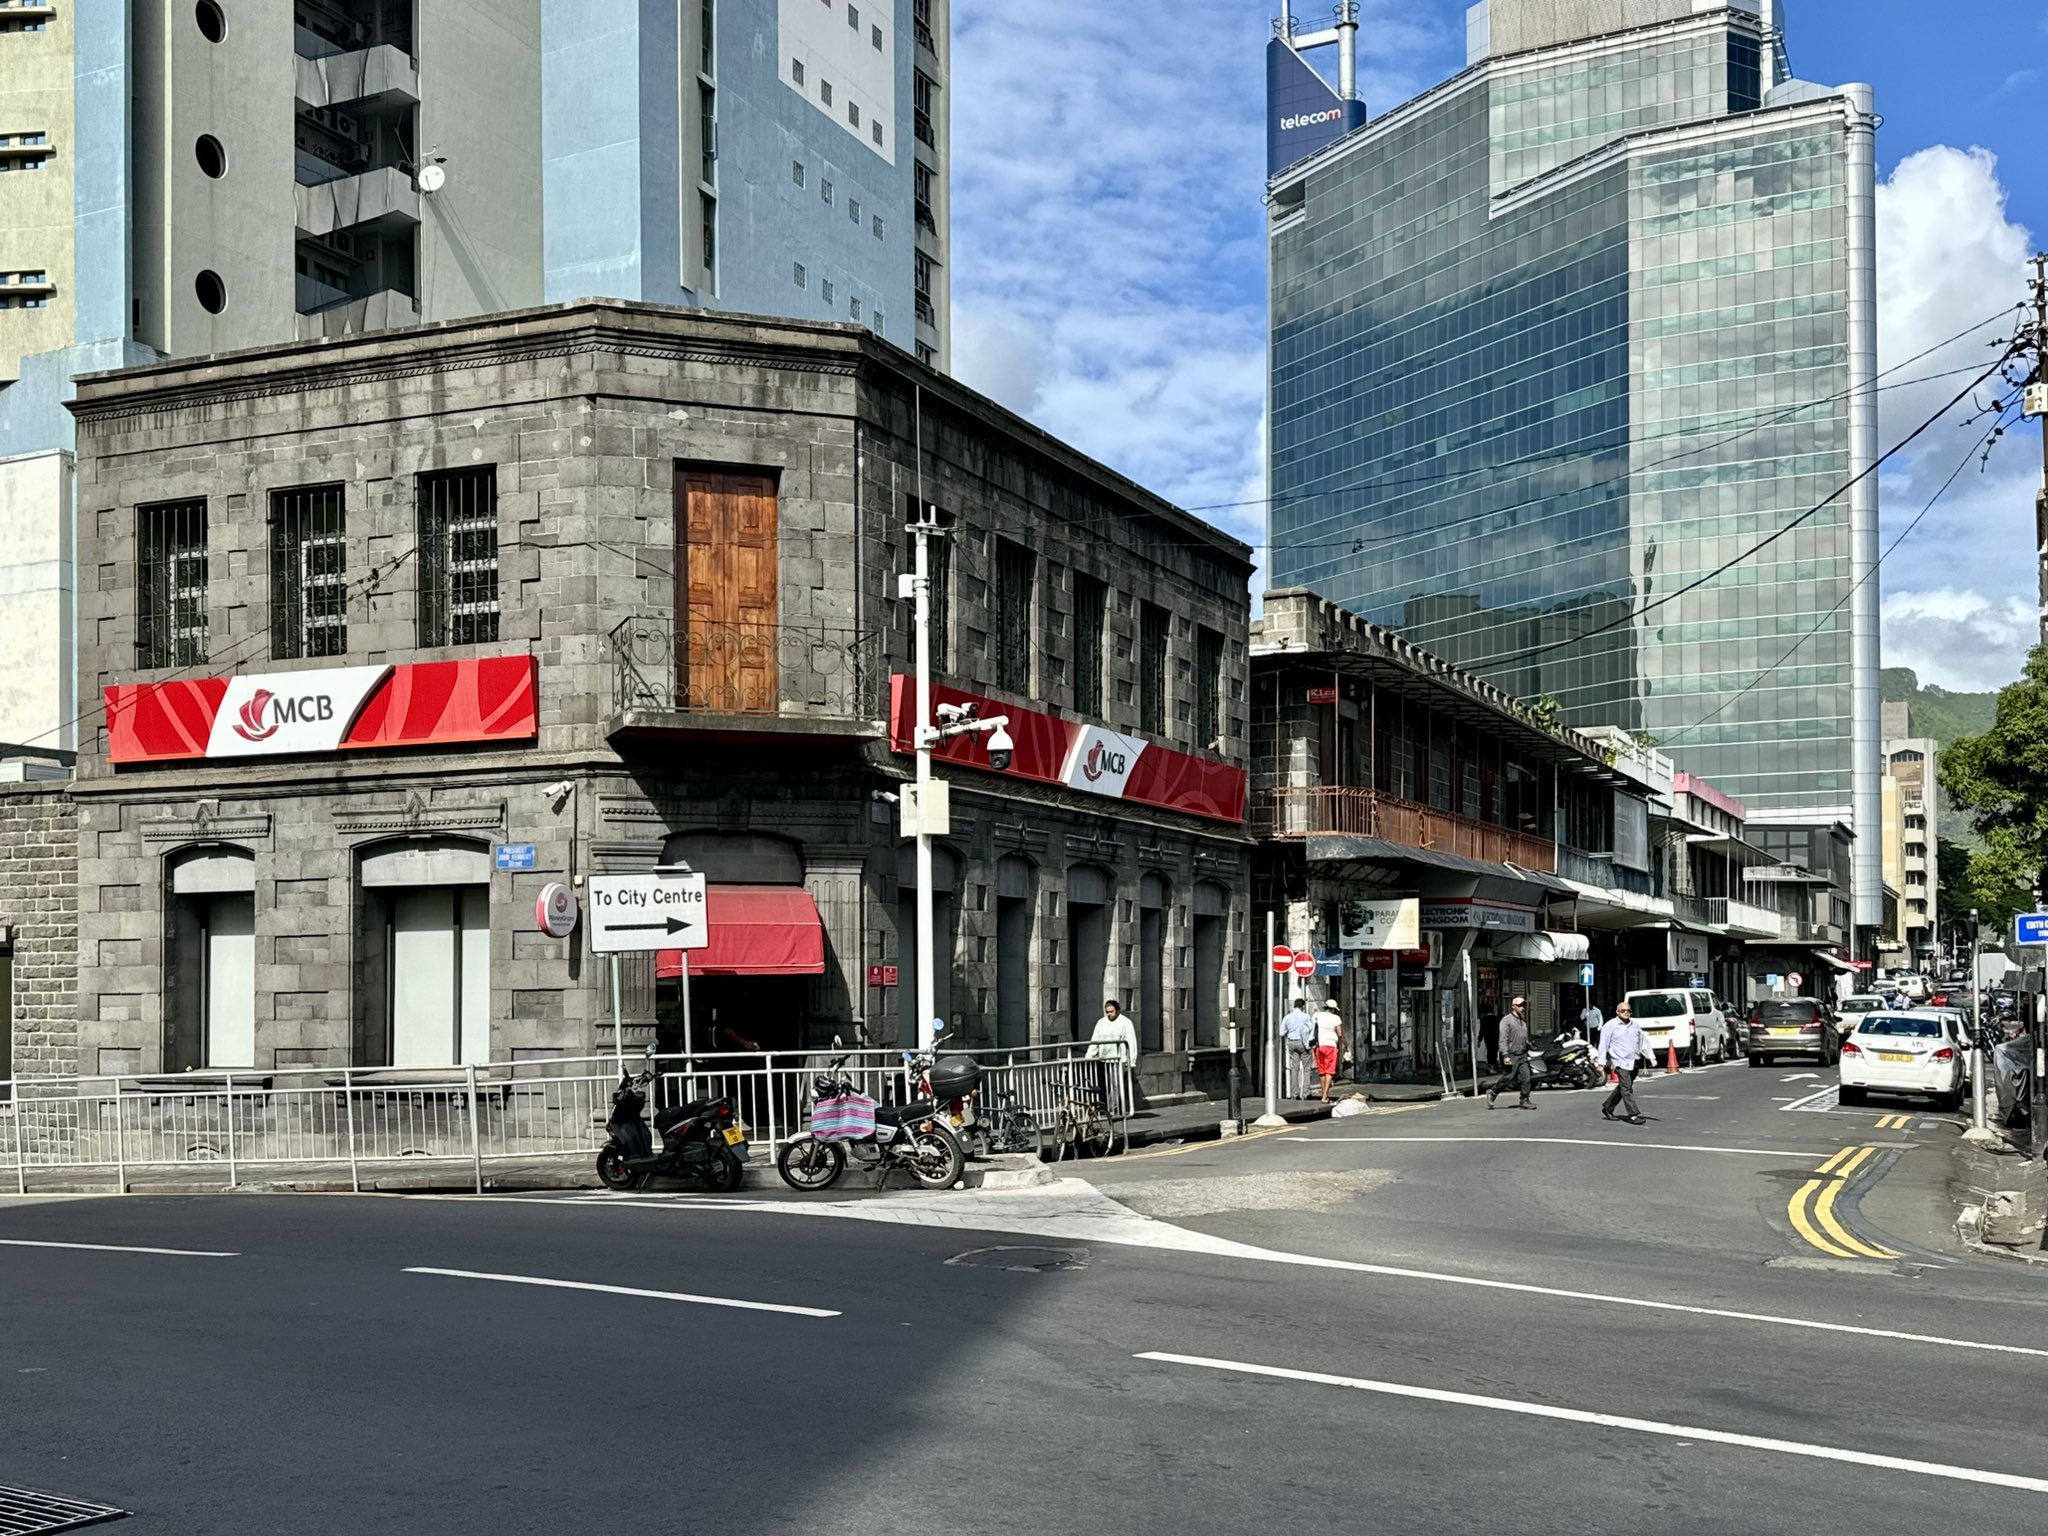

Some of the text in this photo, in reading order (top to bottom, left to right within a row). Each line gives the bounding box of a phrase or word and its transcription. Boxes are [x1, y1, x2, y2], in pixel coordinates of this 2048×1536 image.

[1281, 108, 1341, 130] telecom
[273, 695, 334, 724] MCB
[1101, 750, 1126, 775] MCB
[594, 888, 703, 907] To City Centre
[1421, 907, 1469, 916] LECTRONIC
[2026, 920, 2044, 929] EDITH
